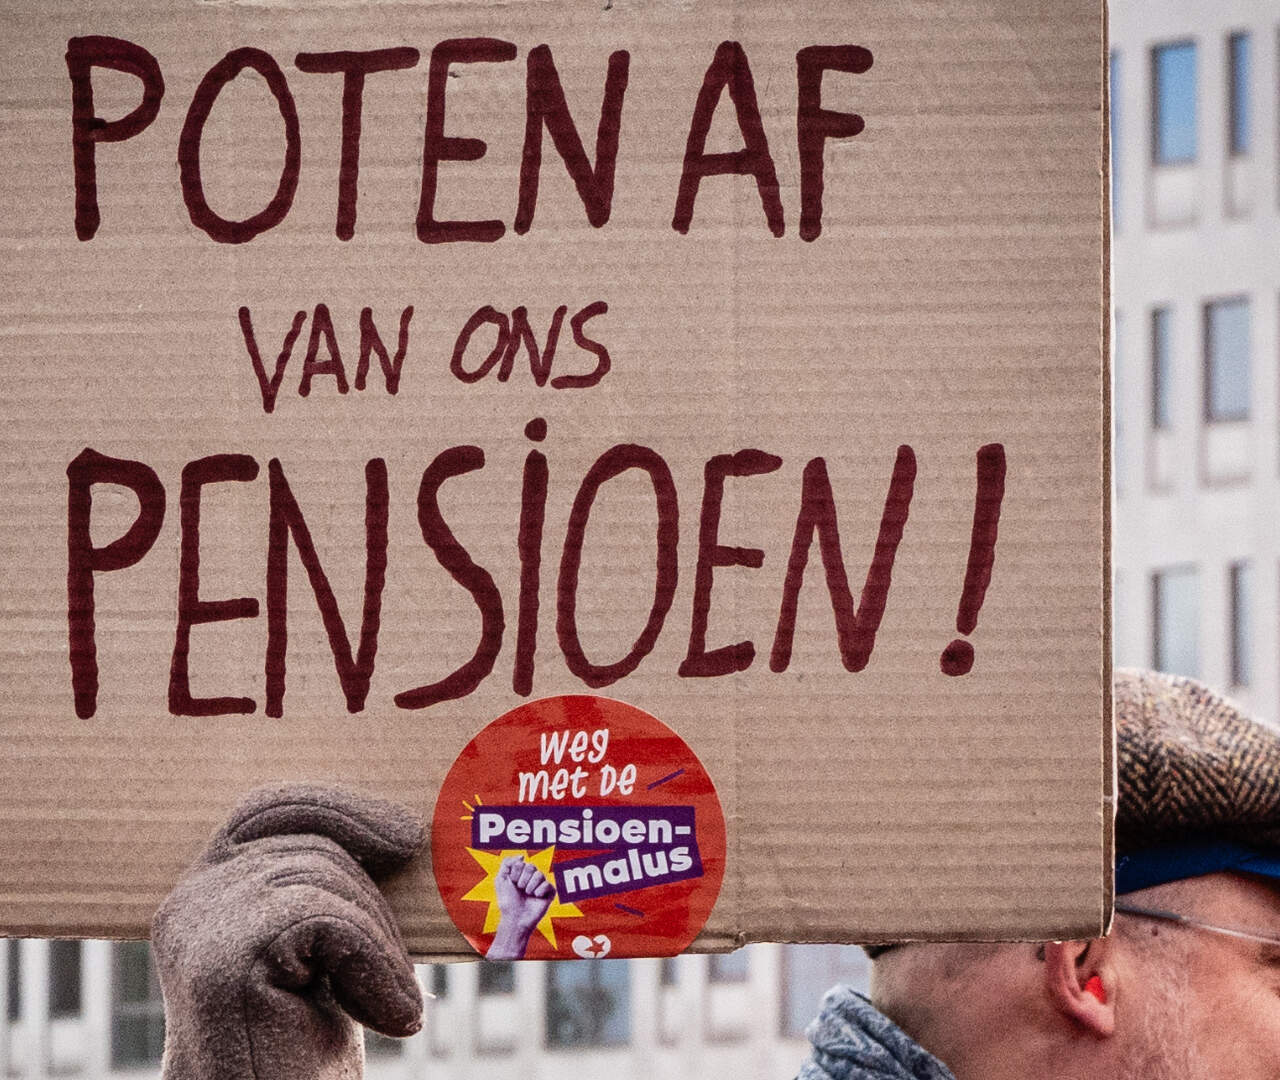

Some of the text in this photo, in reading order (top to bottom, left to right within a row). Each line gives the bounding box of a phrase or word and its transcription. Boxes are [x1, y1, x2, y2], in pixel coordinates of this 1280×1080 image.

[65, 36, 873, 244] POTEN AF
[239, 302, 610, 413] VAN ONS
[518, 767, 588, 803] met
[478, 808, 691, 844] Pensioen-
[563, 846, 693, 893] malus
